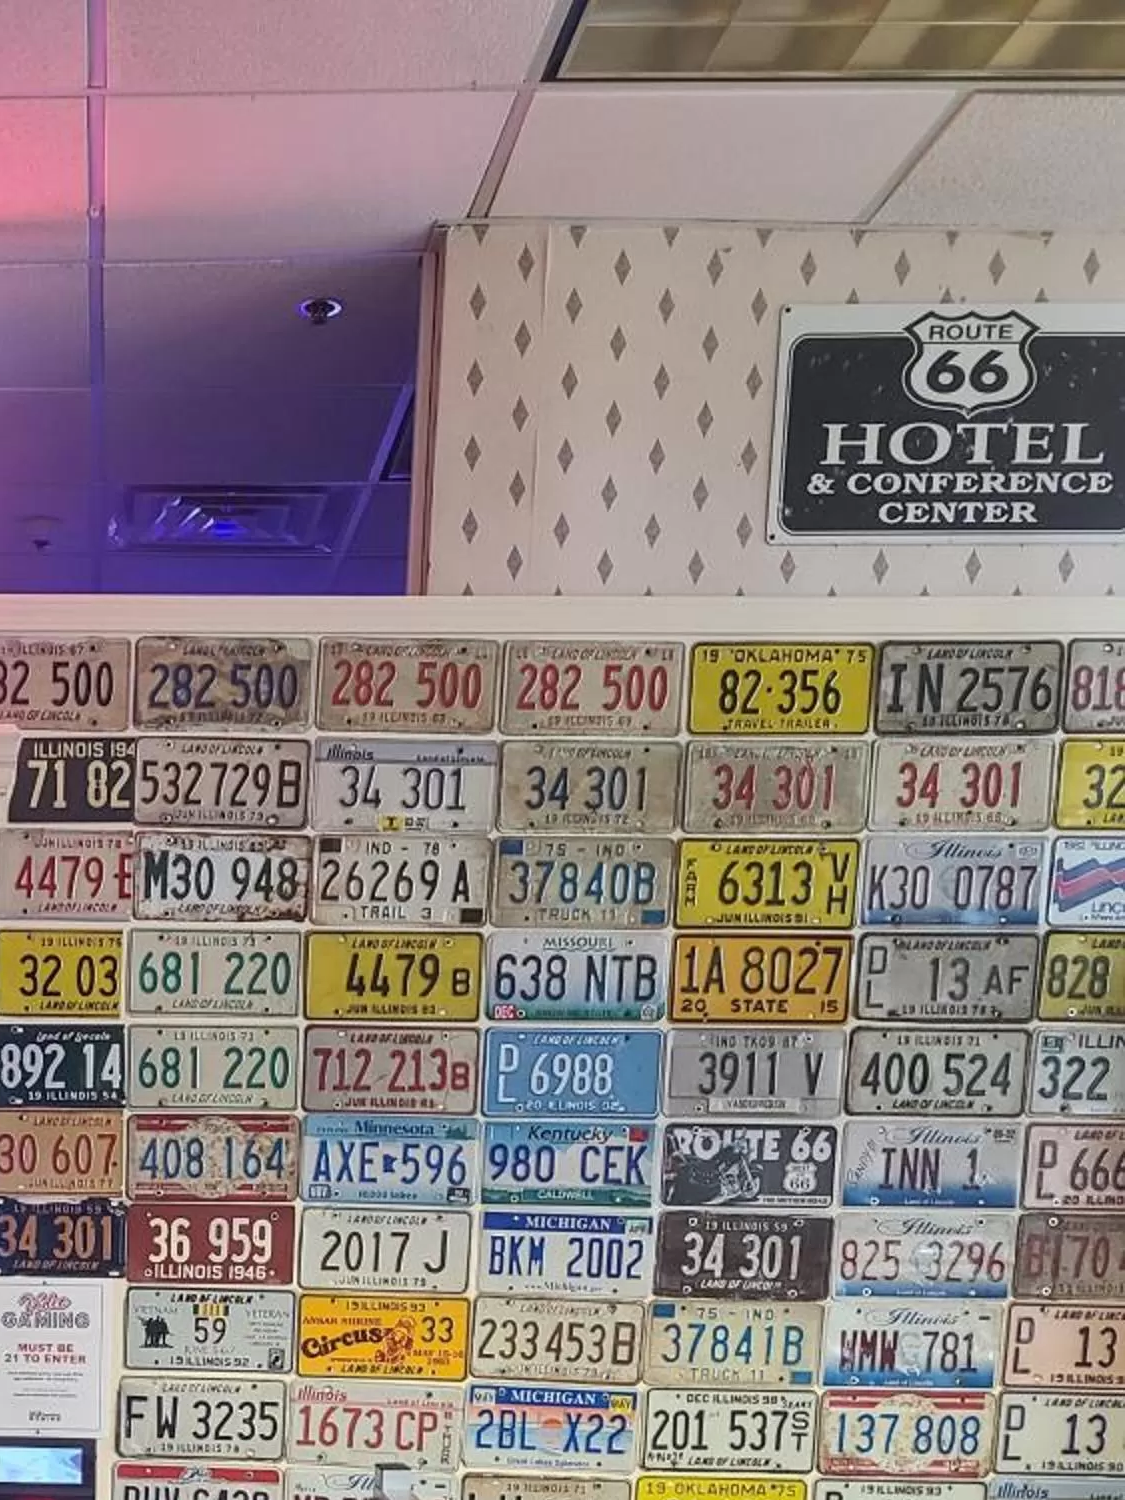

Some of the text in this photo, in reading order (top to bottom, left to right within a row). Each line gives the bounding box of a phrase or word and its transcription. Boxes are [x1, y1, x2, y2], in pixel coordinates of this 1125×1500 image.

[928, 324, 1013, 340] ROUTE
[926, 350, 1008, 394] 66
[820, 422, 1104, 465] HOTEL
[807, 472, 1114, 494] & CONFERENCE
[879, 502, 1037, 523] CENTER
[735, 650, 831, 662] OKLAHOMA
[52, 661, 114, 707] 500
[779, 718, 831, 730] TRAILER
[33, 741, 104, 758] ILLINOIS
[27, 760, 131, 808] 71 82
[341, 766, 465, 809] 34 301
[527, 766, 647, 811] 34 301
[143, 850, 298, 901] M30 948
[360, 907, 406, 919] TRAIL
[139, 953, 292, 994] 681 220
[495, 956, 657, 999] 638 NTB
[681, 948, 843, 996] 1A 8027
[730, 999, 789, 1014] STATE
[0, 1045, 121, 1088] 892 14
[532, 1056, 612, 1095] 6988
[861, 1052, 1011, 1097] 400 524
[355, 1121, 435, 1137] Minnesota
[527, 1126, 612, 1144] Kentucky
[677, 1127, 832, 1161] ROUTE 66
[138, 1138, 286, 1179] 408 164
[313, 1143, 466, 1185] AXE 596
[489, 1146, 646, 1186] 980 CEK
[538, 1189, 594, 1200] CALDWELL
[149, 1217, 272, 1263] 36 959
[525, 1215, 610, 1230] MICHIGAN
[155, 1264, 265, 1280] ILLINOIS 1946
[489, 1237, 643, 1279] BKM 2002
[1, 1311, 89, 1329] GAMING
[194, 1319, 226, 1345] 59
[302, 1318, 454, 1356] Circus 33
[4, 1355, 86, 1364] 21 TO ENTER
[17, 1344, 74, 1353] MUST BE
[192, 1401, 277, 1441] 3235
[297, 1406, 438, 1450] 1673 CP
